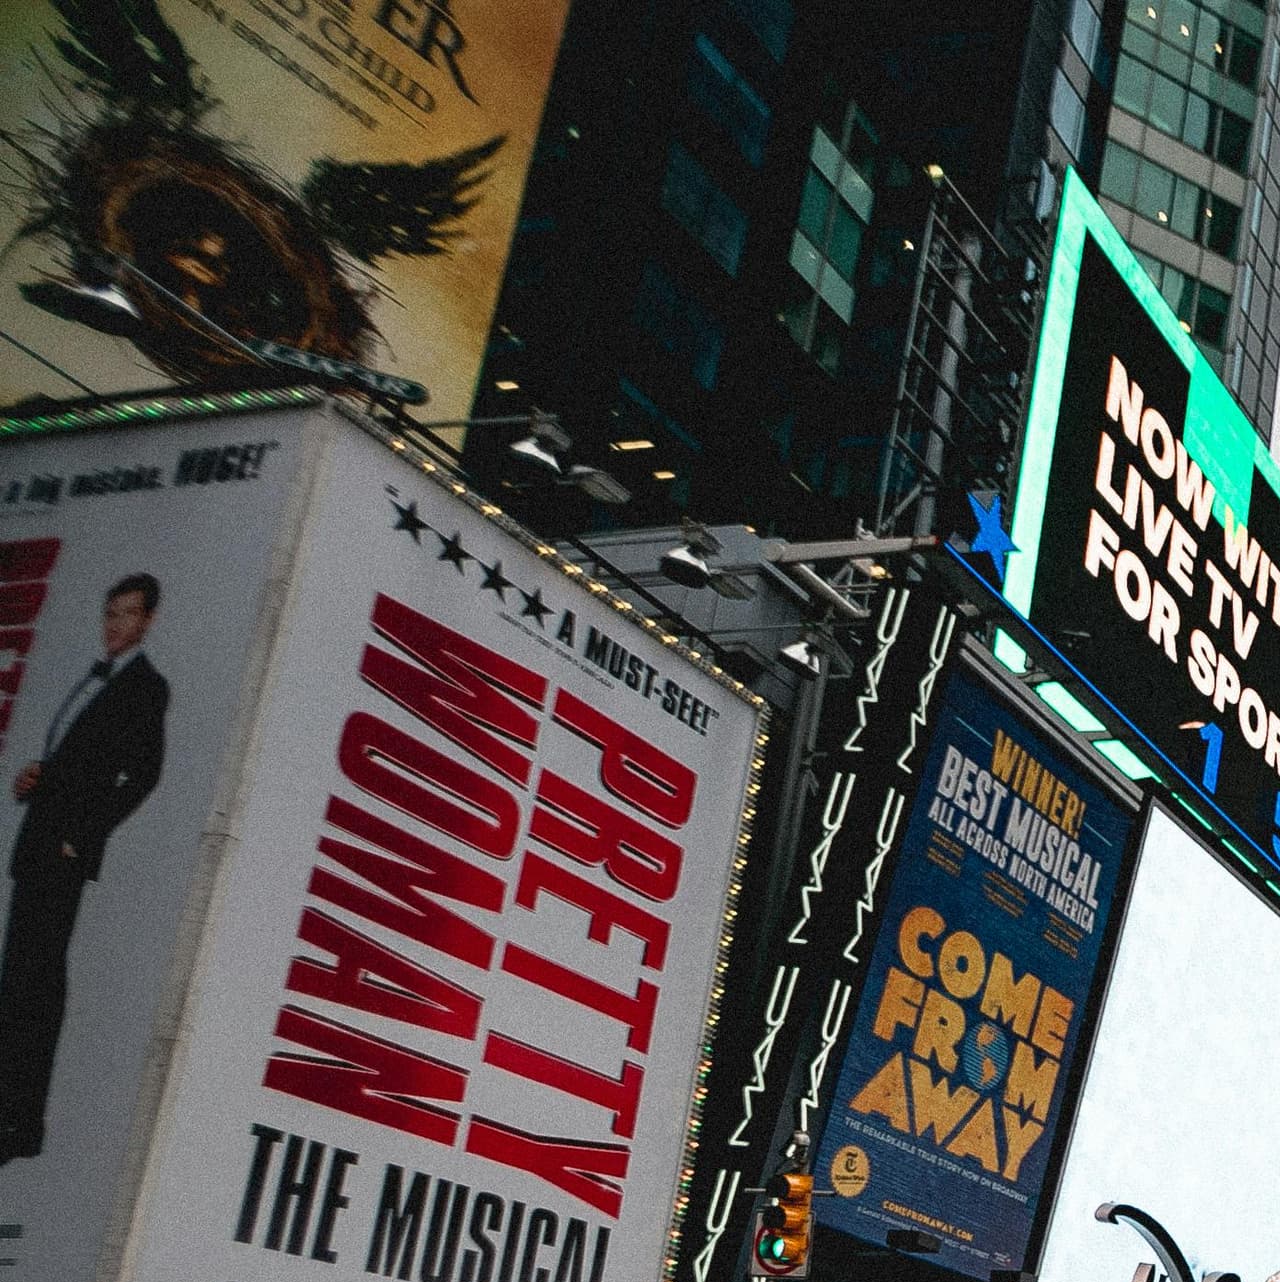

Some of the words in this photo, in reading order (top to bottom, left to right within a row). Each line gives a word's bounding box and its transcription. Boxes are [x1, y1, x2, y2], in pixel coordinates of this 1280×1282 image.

[1107, 356, 1216, 527] NOW
[1086, 510, 1180, 664] FOR
[1096, 430, 1199, 590] LIVE
[1204, 562, 1260, 662] TV
[556, 609, 576, 648] A
[937, 745, 1008, 831] BEST
[1004, 797, 1101, 908] MUSICAL
[992, 728, 1086, 840] WINNER!
[262, 591, 550, 1146] WOMAN
[928, 797, 953, 832] ALL
[956, 816, 1009, 869] ACROSS
[1010, 854, 1048, 899] NORTH
[1047, 883, 1094, 934] AMERICA
[466, 688, 698, 1219] PRETTY
[898, 907, 1074, 1057] COME
[845, 1117, 860, 1131] THE
[863, 1124, 915, 1155] REMARKABLE
[917, 1148, 937, 1163] TRUE
[938, 1156, 961, 1174] STORY
[962, 1168, 979, 1183] NOW
[849, 1053, 1044, 1181] AWAY
[235, 1123, 358, 1263] THE
